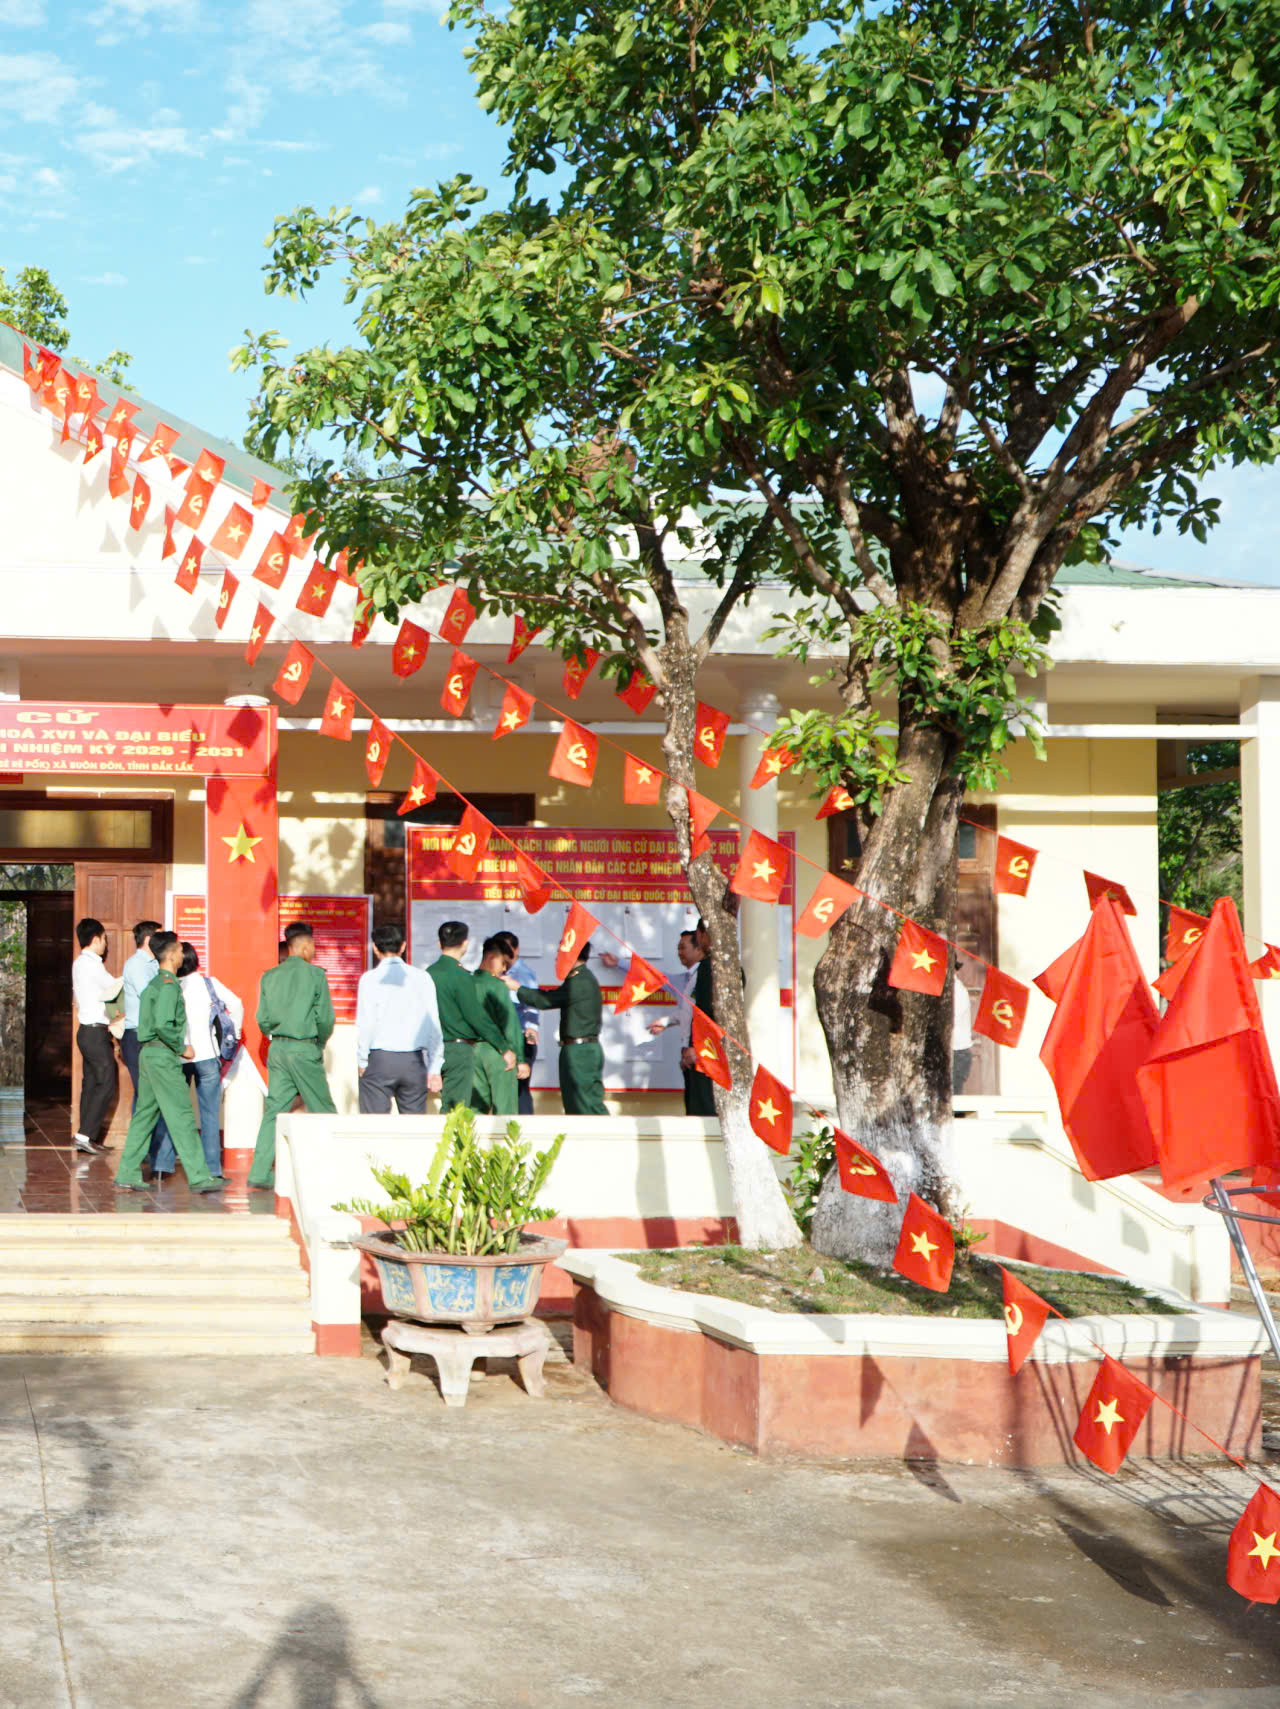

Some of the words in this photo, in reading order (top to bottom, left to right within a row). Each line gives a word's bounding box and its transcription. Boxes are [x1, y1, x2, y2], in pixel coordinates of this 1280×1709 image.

[16, 709, 100, 724] CỬ
[42, 730, 76, 740] XVI
[82, 729, 109, 741] VÀ
[115, 731, 151, 742] ĐẠI
[157, 729, 206, 742] BIỂU
[14, 742, 83, 755] NHIỆM
[122, 745, 174, 756] 2026
[195, 747, 244, 757] 2031
[517, 837, 543, 852] SÁCH
[580, 839, 609, 853] NGƯỜI
[607, 859, 628, 874] CÁC
